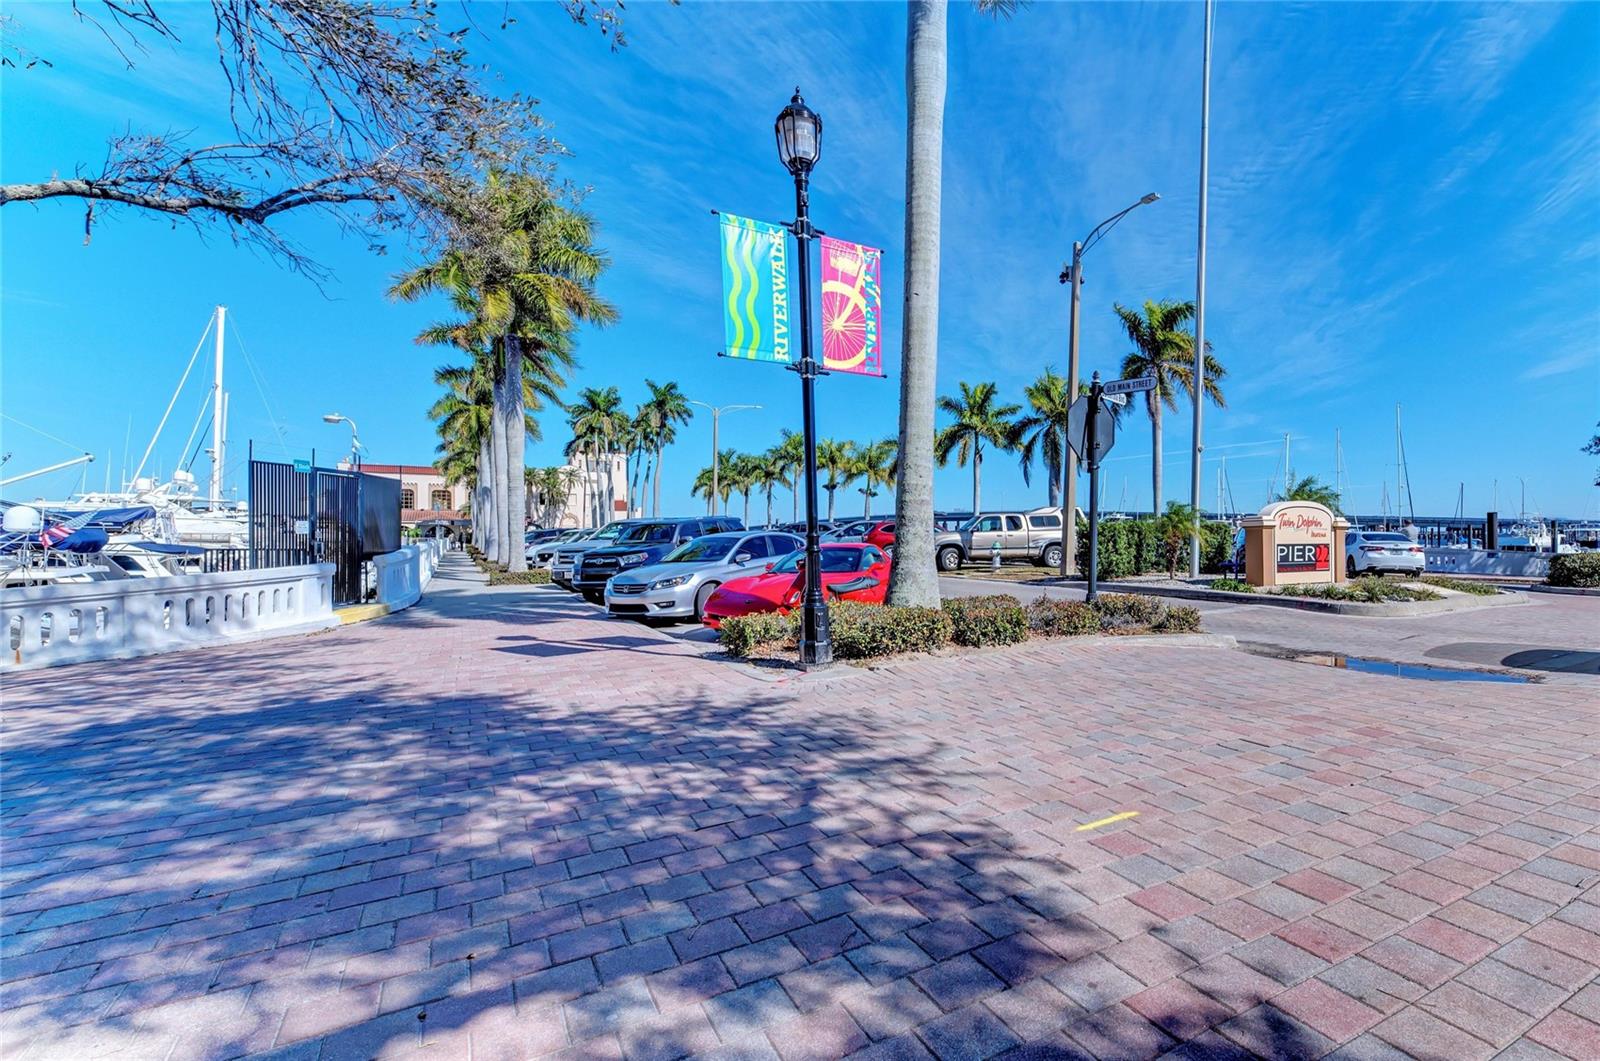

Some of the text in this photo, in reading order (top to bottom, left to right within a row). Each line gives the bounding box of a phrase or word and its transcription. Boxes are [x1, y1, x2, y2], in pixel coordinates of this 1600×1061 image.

[769, 227, 789, 362] RIVERWALK
[1106, 379, 1152, 392] OLD MAIN STREET
[1279, 513, 1323, 534] Twin Dolphin
[1277, 545, 1316, 562] PIER
